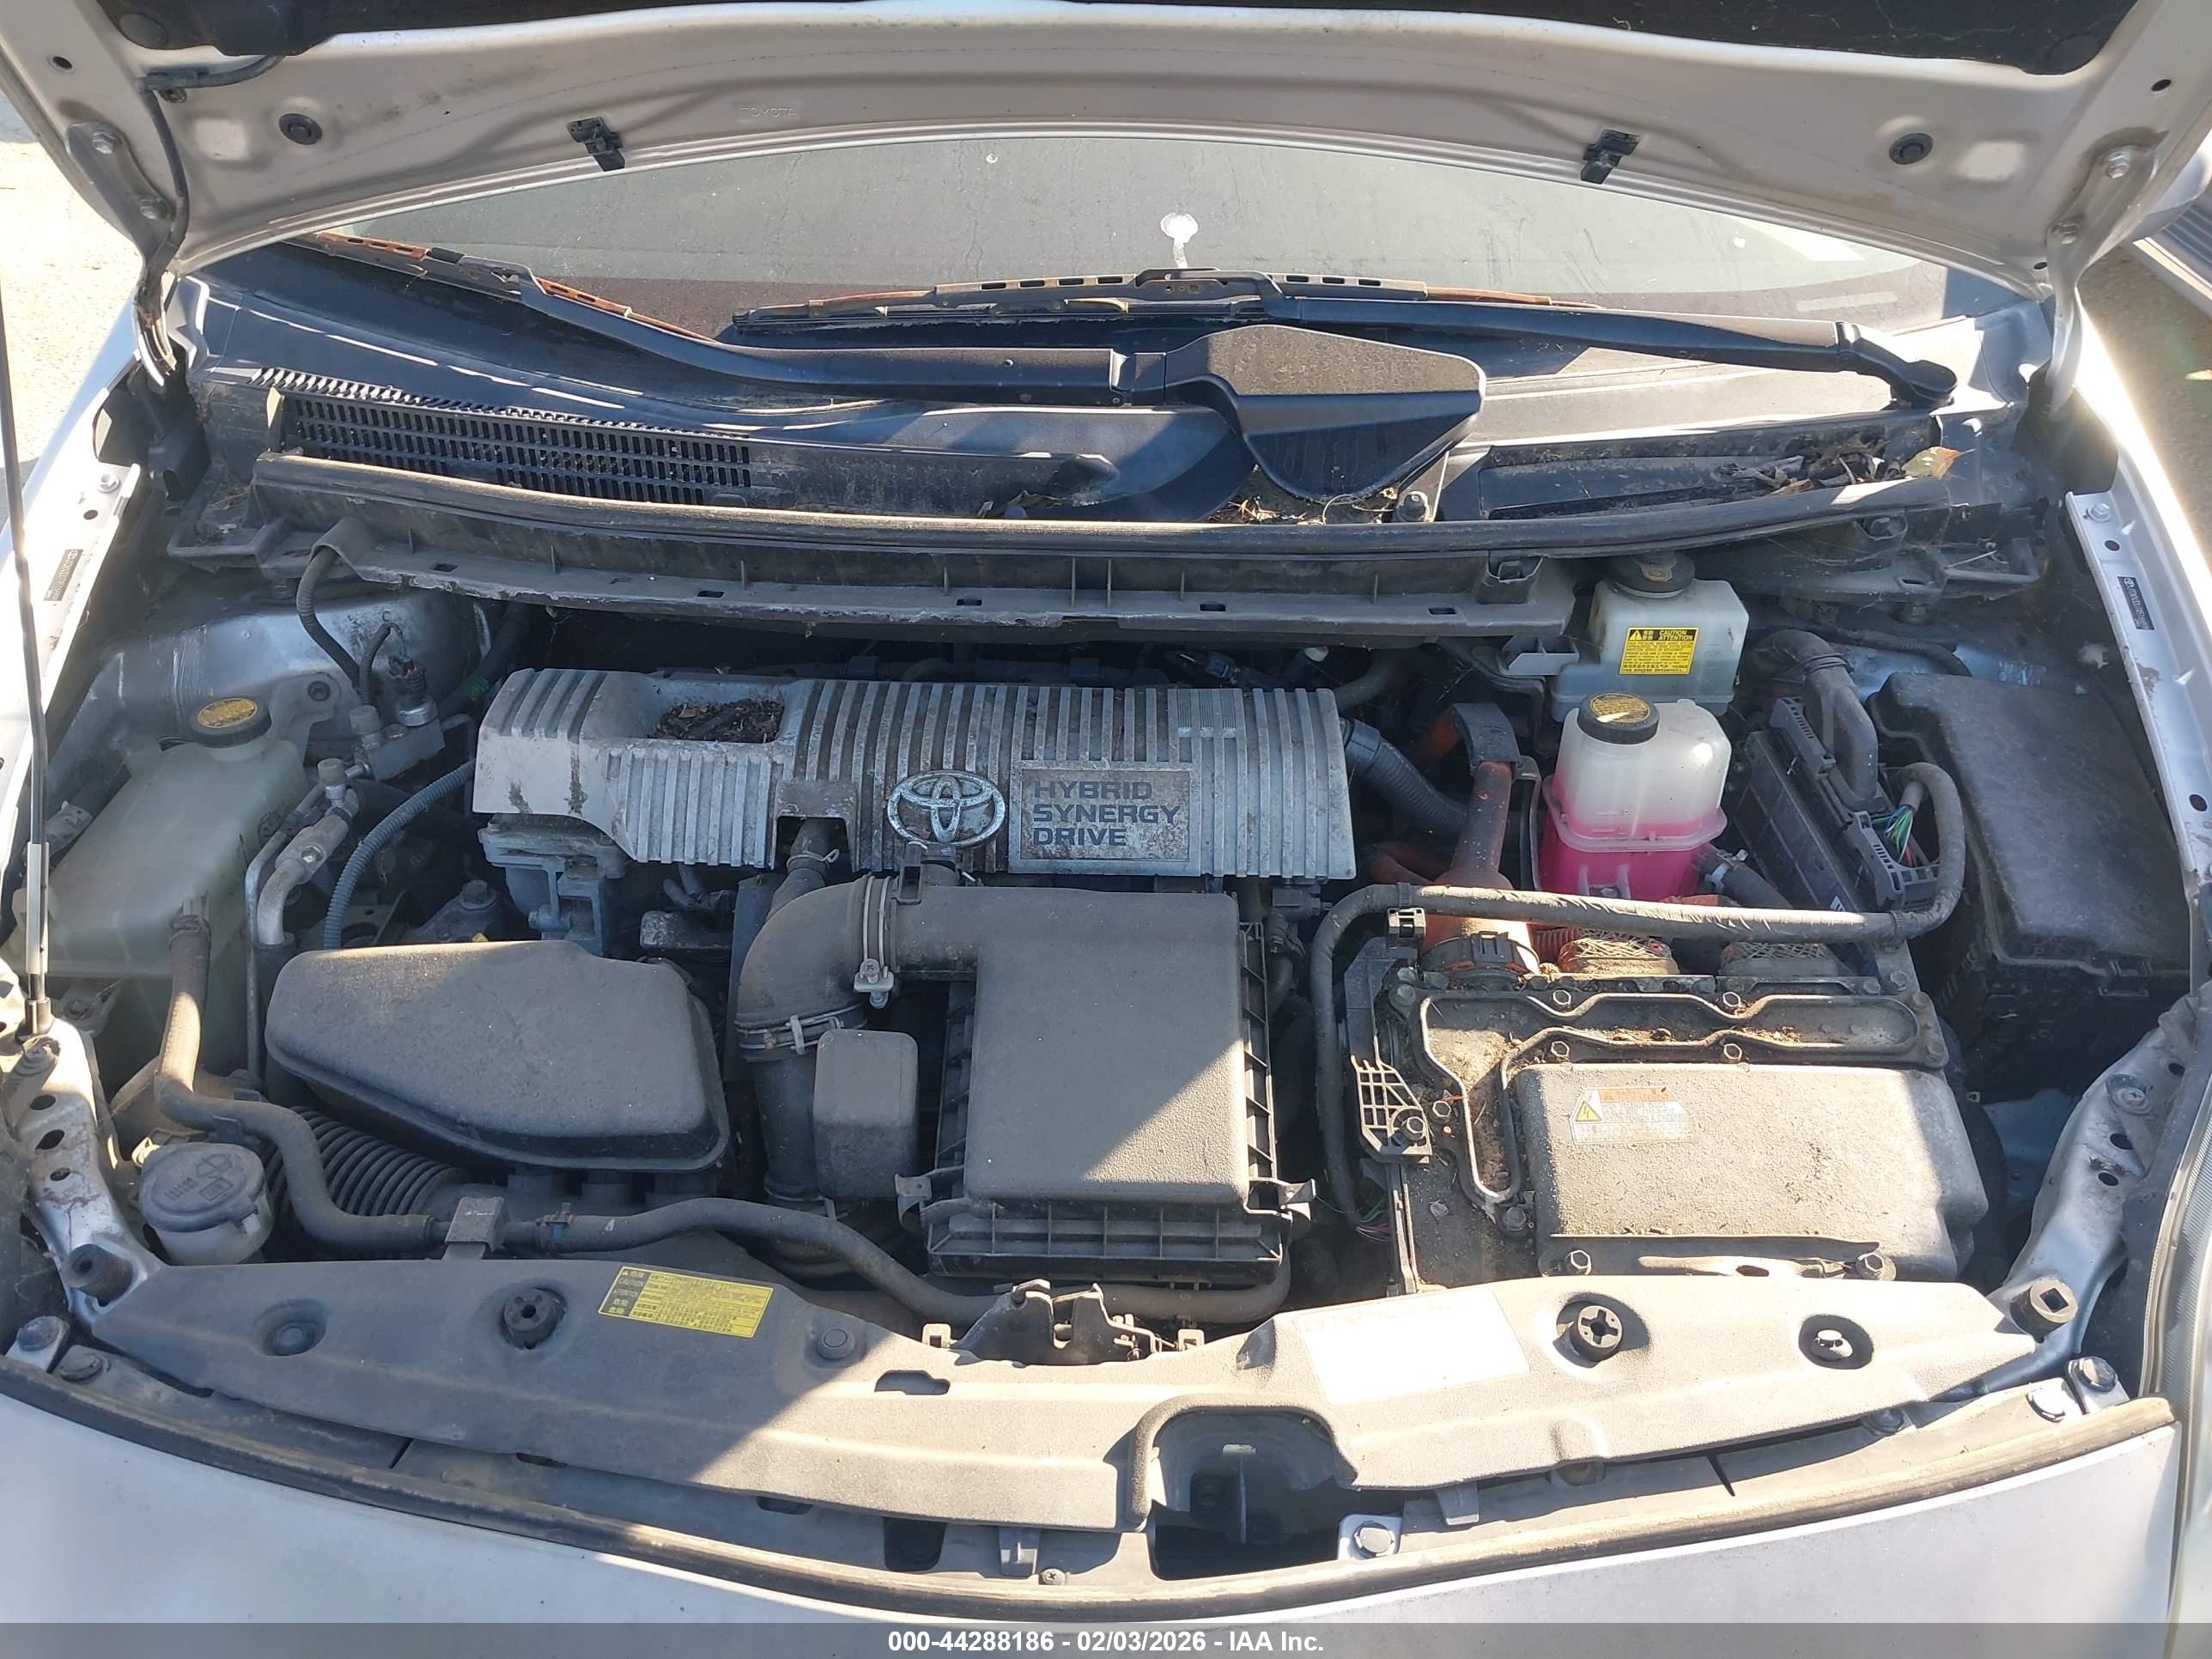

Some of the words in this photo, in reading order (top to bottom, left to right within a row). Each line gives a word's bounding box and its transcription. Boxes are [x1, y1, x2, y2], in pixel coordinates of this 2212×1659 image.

[1034, 781, 1152, 799] HYBRID
[1033, 804, 1181, 824] SYNERGY
[1033, 827, 1127, 846] DRIVE
